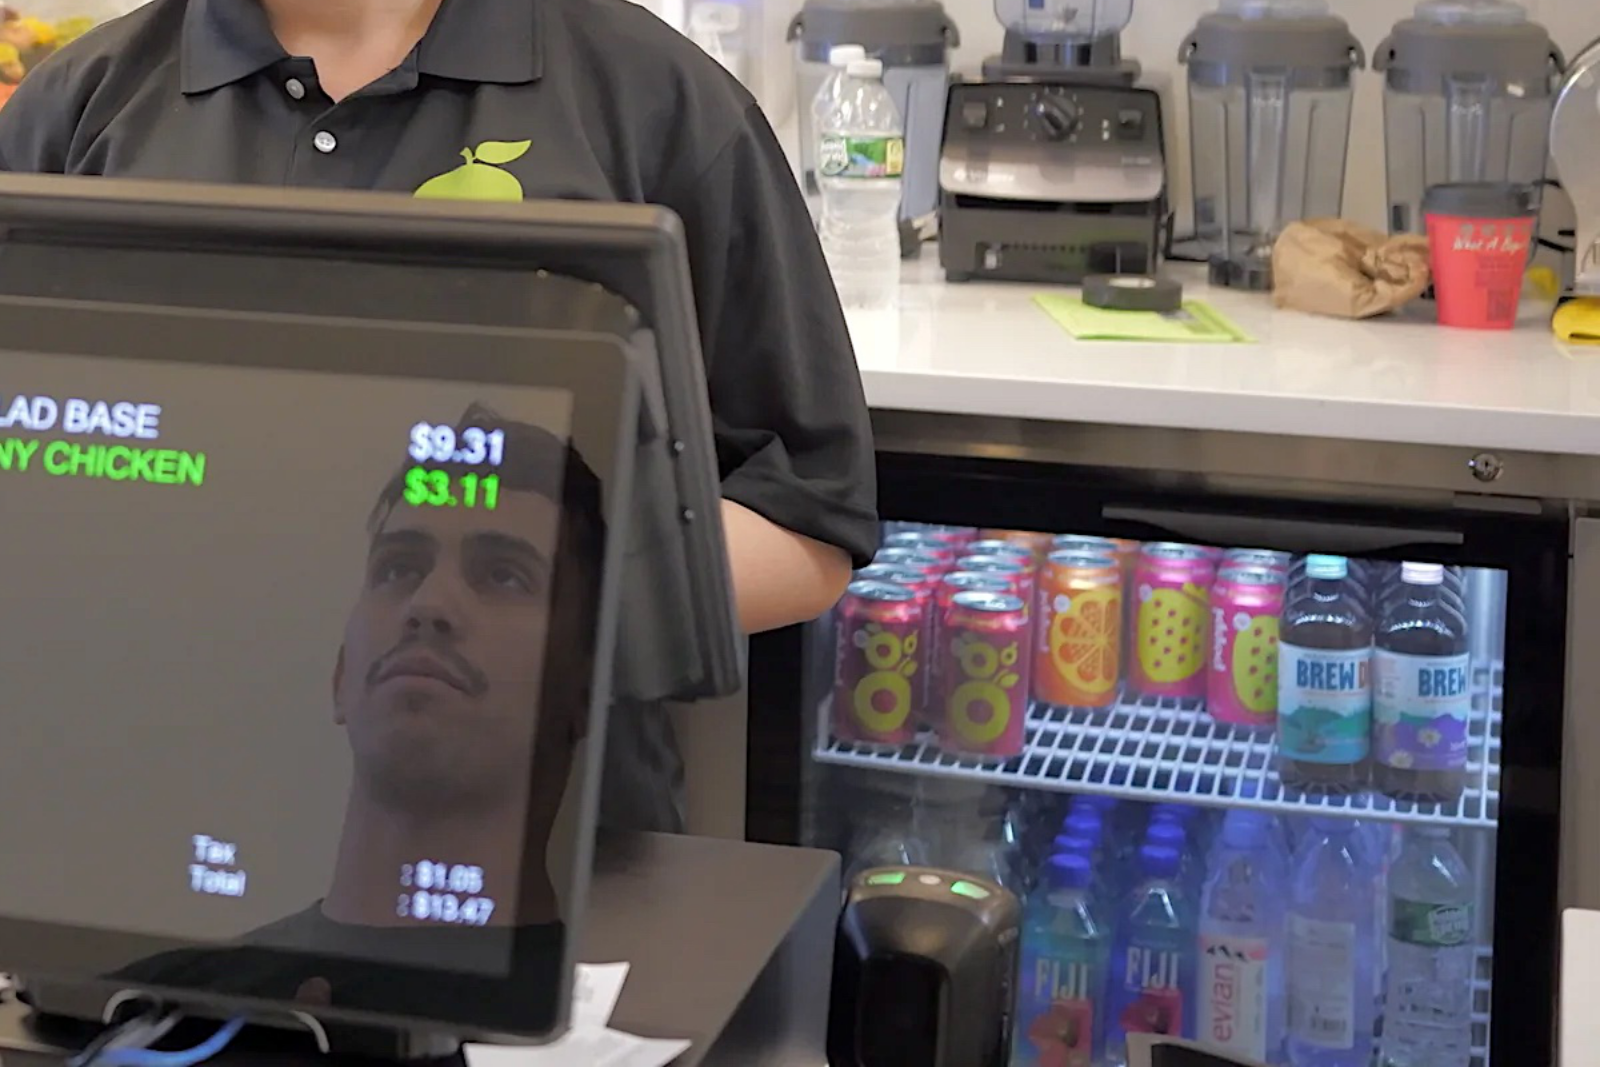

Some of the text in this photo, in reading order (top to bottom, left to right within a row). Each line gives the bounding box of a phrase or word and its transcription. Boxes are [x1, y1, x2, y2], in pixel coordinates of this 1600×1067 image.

[63, 398, 162, 439] BASE
[43, 440, 206, 486] CHICKEN
[408, 421, 504, 466] $9.31
[403, 465, 500, 510] $3.11
[1296, 660, 1355, 690] BREW
[191, 834, 236, 865] Tax
[189, 864, 246, 897] Total
[1034, 958, 1089, 1000] FIJI
[1124, 946, 1179, 990] FIJI
[1212, 963, 1234, 1042] evian
